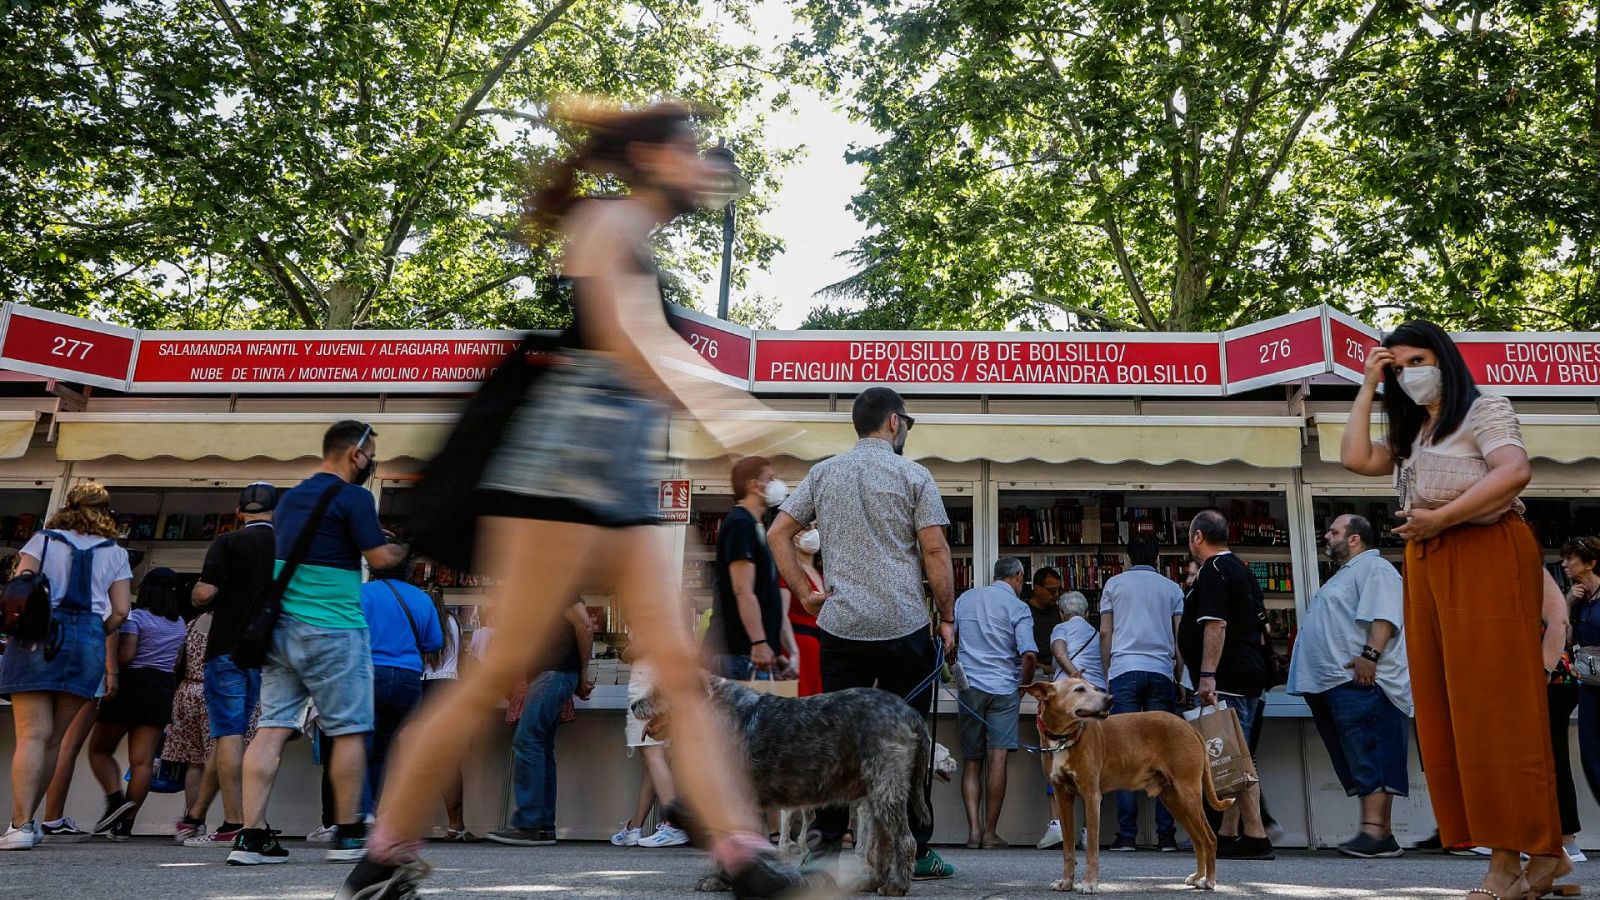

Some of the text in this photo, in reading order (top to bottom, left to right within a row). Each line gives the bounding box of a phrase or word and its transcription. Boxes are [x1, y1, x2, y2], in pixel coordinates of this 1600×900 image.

[51, 336, 94, 360] 277
[159, 343, 242, 356] SALAMANDRA
[247, 343, 299, 356] INFANTIL
[305, 343, 313, 356] Y
[316, 343, 366, 356] JUVENIL
[370, 343, 377, 356] /
[379, 343, 450, 356] ALFAGUARA
[454, 343, 507, 356] INFANTIL
[689, 333, 719, 359] 276
[849, 342, 964, 361] DEBOLSILLO
[997, 343, 1021, 361] DE
[1259, 338, 1291, 364] 276
[1346, 338, 1365, 363] 275
[190, 367, 223, 380] NUBE
[231, 367, 248, 380] DE
[253, 367, 286, 380] TINTA
[289, 367, 296, 380] /
[299, 367, 358, 380] MONTENA
[362, 367, 369, 380] /
[372, 367, 420, 380] MOLINO
[422, 367, 429, 380] /
[432, 367, 486, 380] RANDOM
[770, 360, 1207, 384] PENGUIN CLÁSICOS / SALAMANDRA BOLSILLO
[1486, 363, 1600, 383] NOVA / BRU
